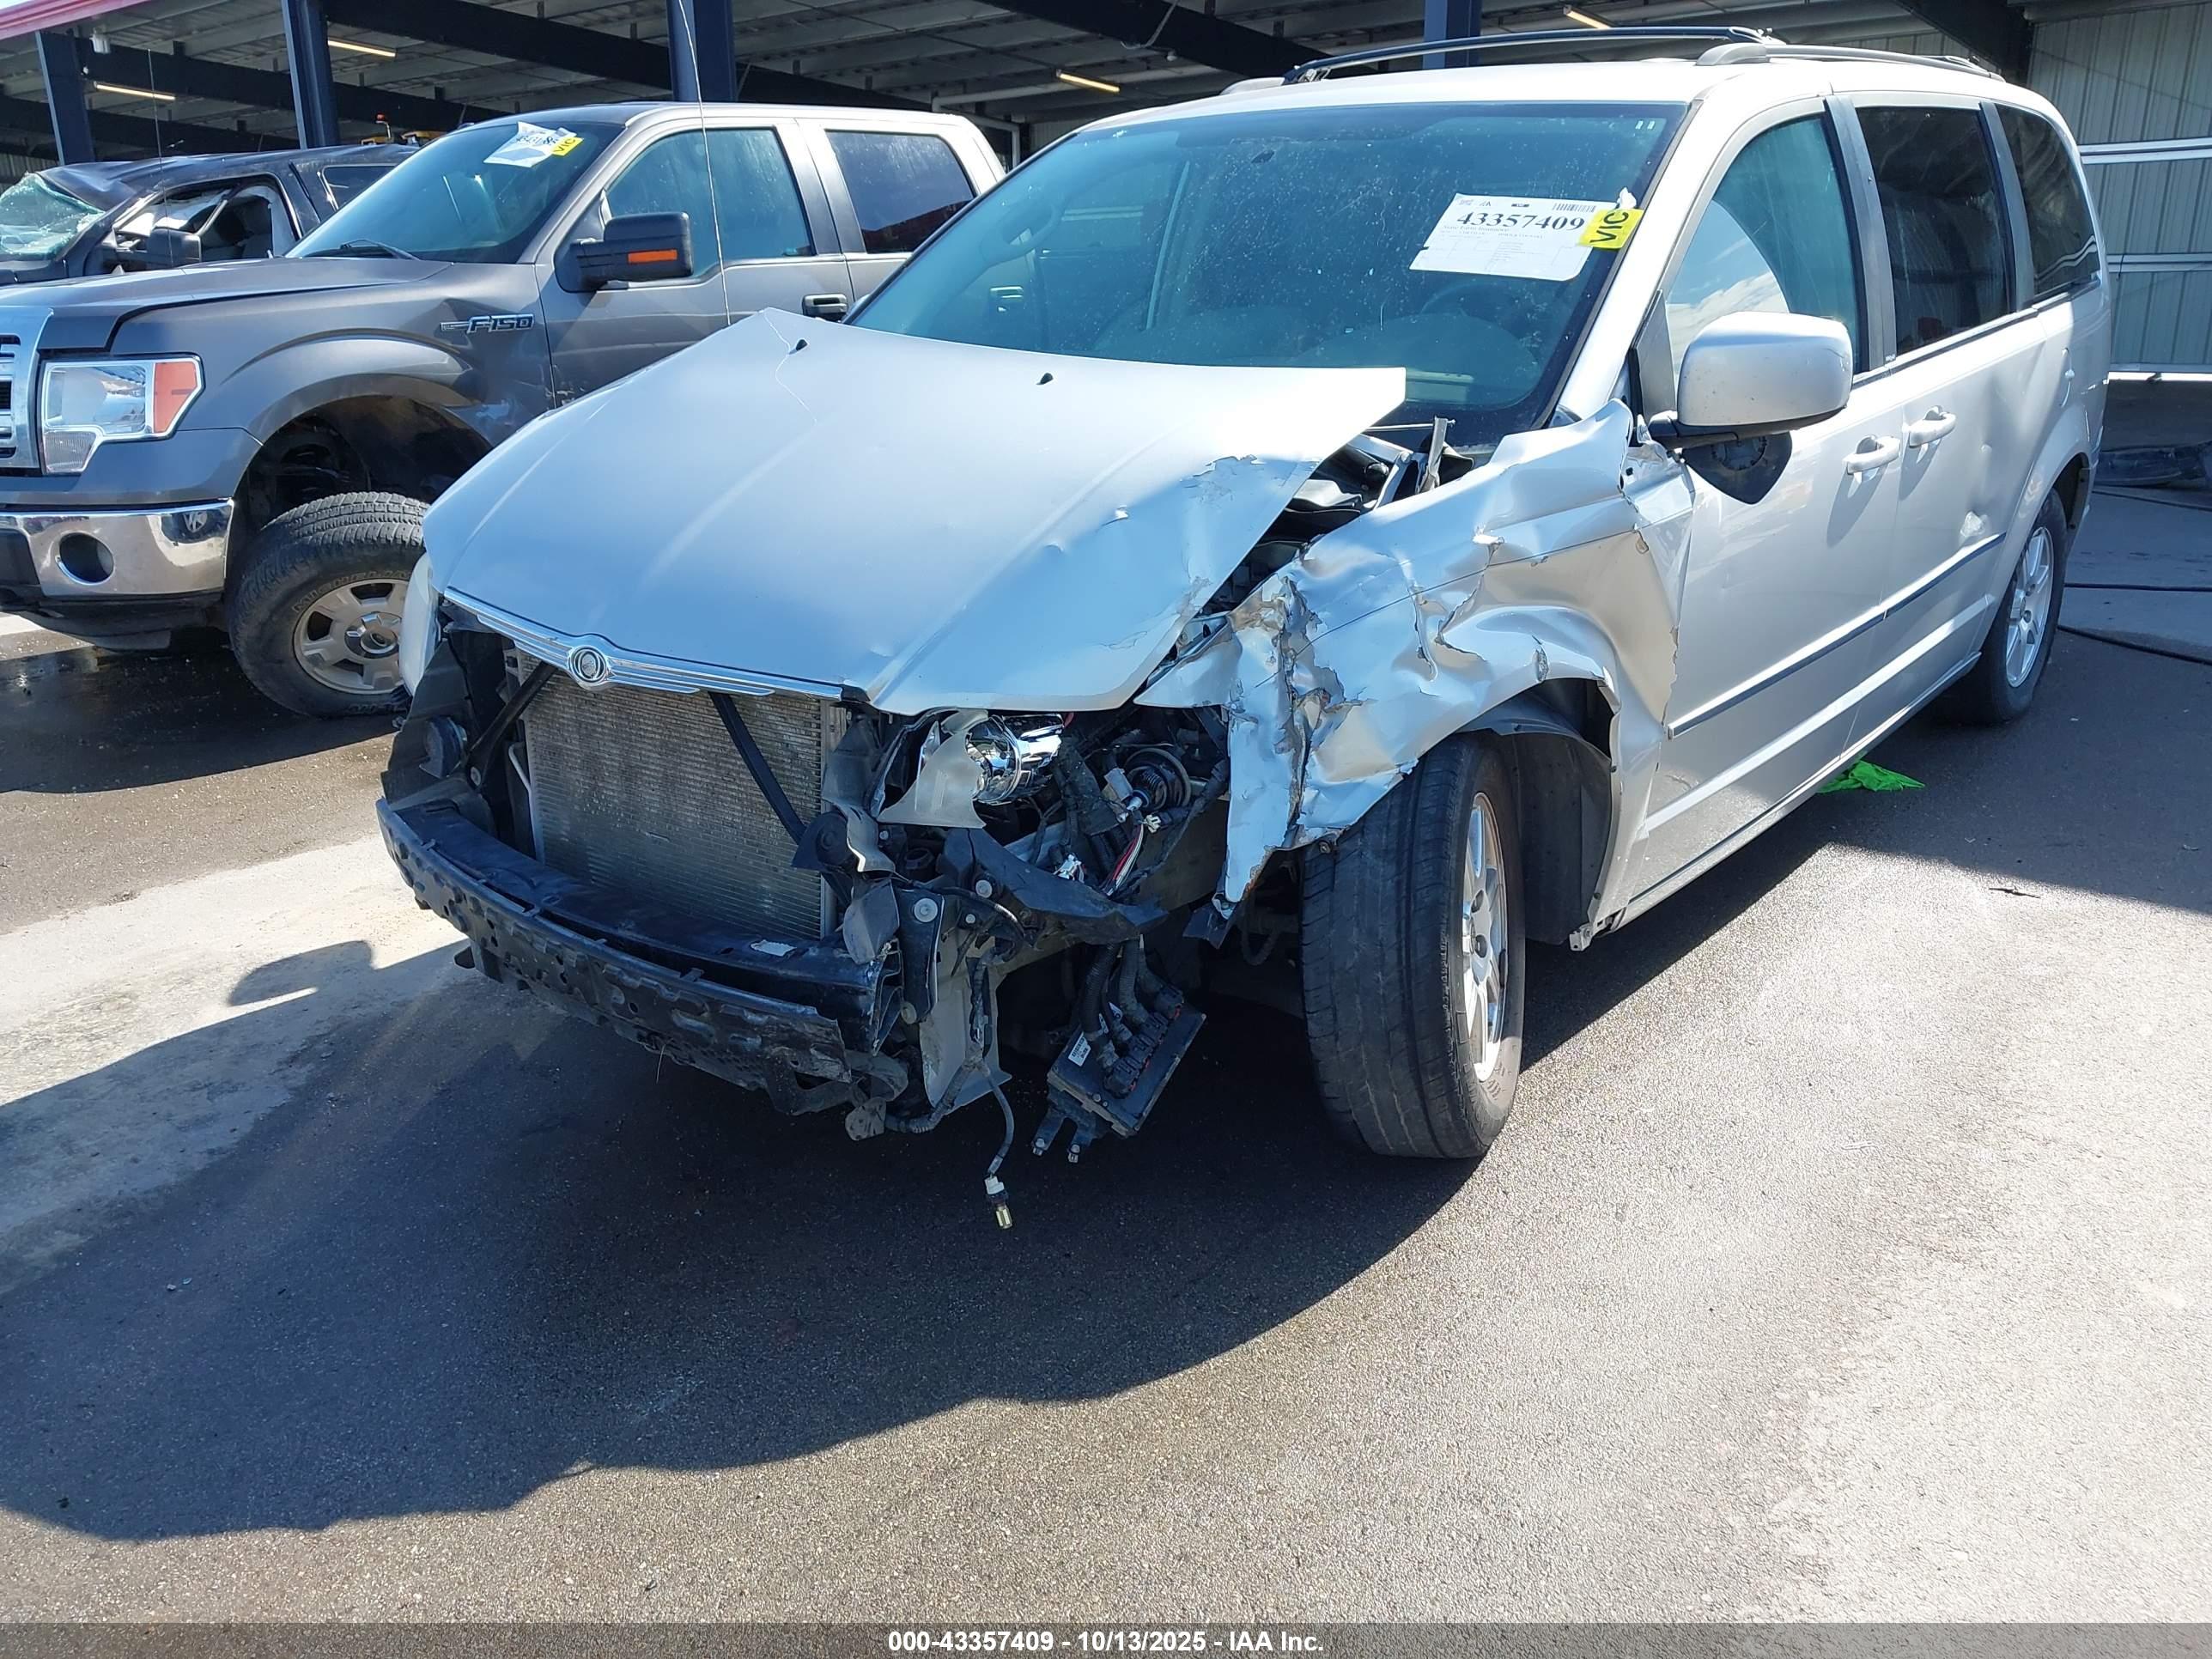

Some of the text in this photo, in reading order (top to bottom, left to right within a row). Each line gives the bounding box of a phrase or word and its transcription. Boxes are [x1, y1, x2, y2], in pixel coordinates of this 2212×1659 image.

[553, 137, 576, 153] VIC
[1456, 211, 1585, 231] 43357409
[1589, 211, 1630, 244] VIC
